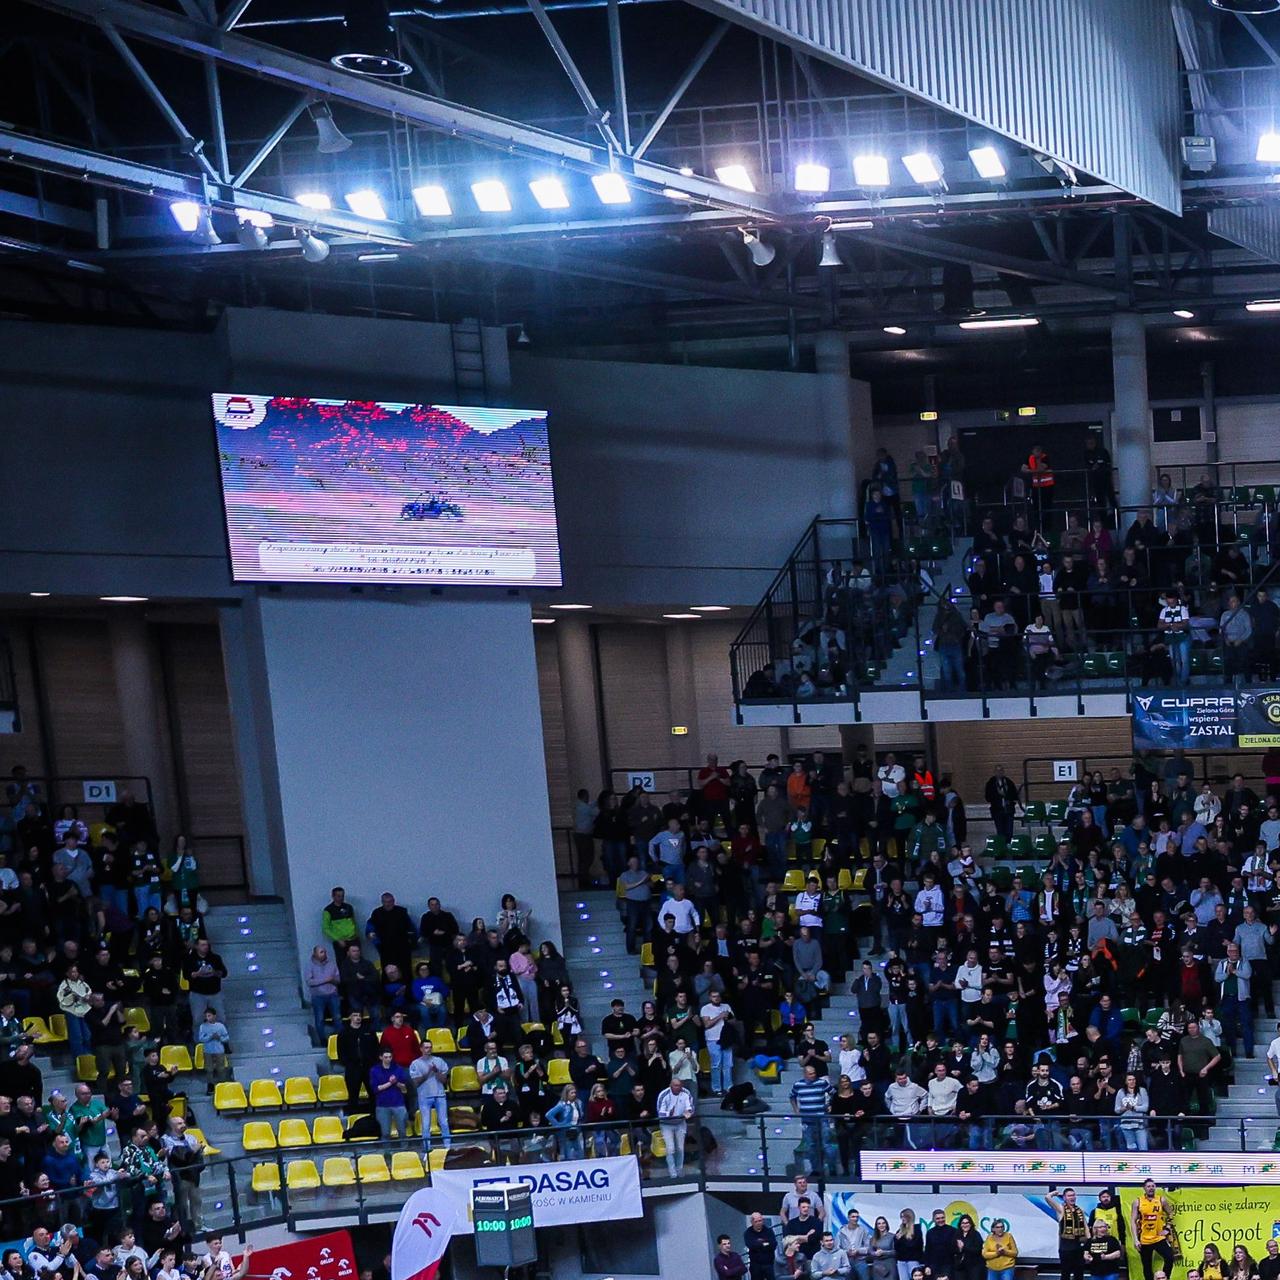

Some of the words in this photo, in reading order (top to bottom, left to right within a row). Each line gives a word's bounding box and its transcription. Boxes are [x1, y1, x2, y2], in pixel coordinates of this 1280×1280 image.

[1161, 697, 1235, 708] CUPRA
[1189, 716, 1219, 724] wspiera
[1190, 725, 1235, 737] ZASTAL
[1244, 736, 1271, 744] ZIELONA
[1058, 765, 1073, 777] E1
[89, 786, 111, 799] D1
[518, 1168, 610, 1195] DASAG
[559, 1197, 568, 1206] W
[569, 1193, 612, 1205] KAMIENIU
[1205, 1202, 1215, 1210] co
[1216, 1200, 1233, 1213] się
[1235, 1197, 1271, 1214] zdarzy
[476, 1220, 506, 1231] 10:00
[510, 1215, 532, 1230] 10:00
[1211, 1220, 1263, 1248] Sopot
